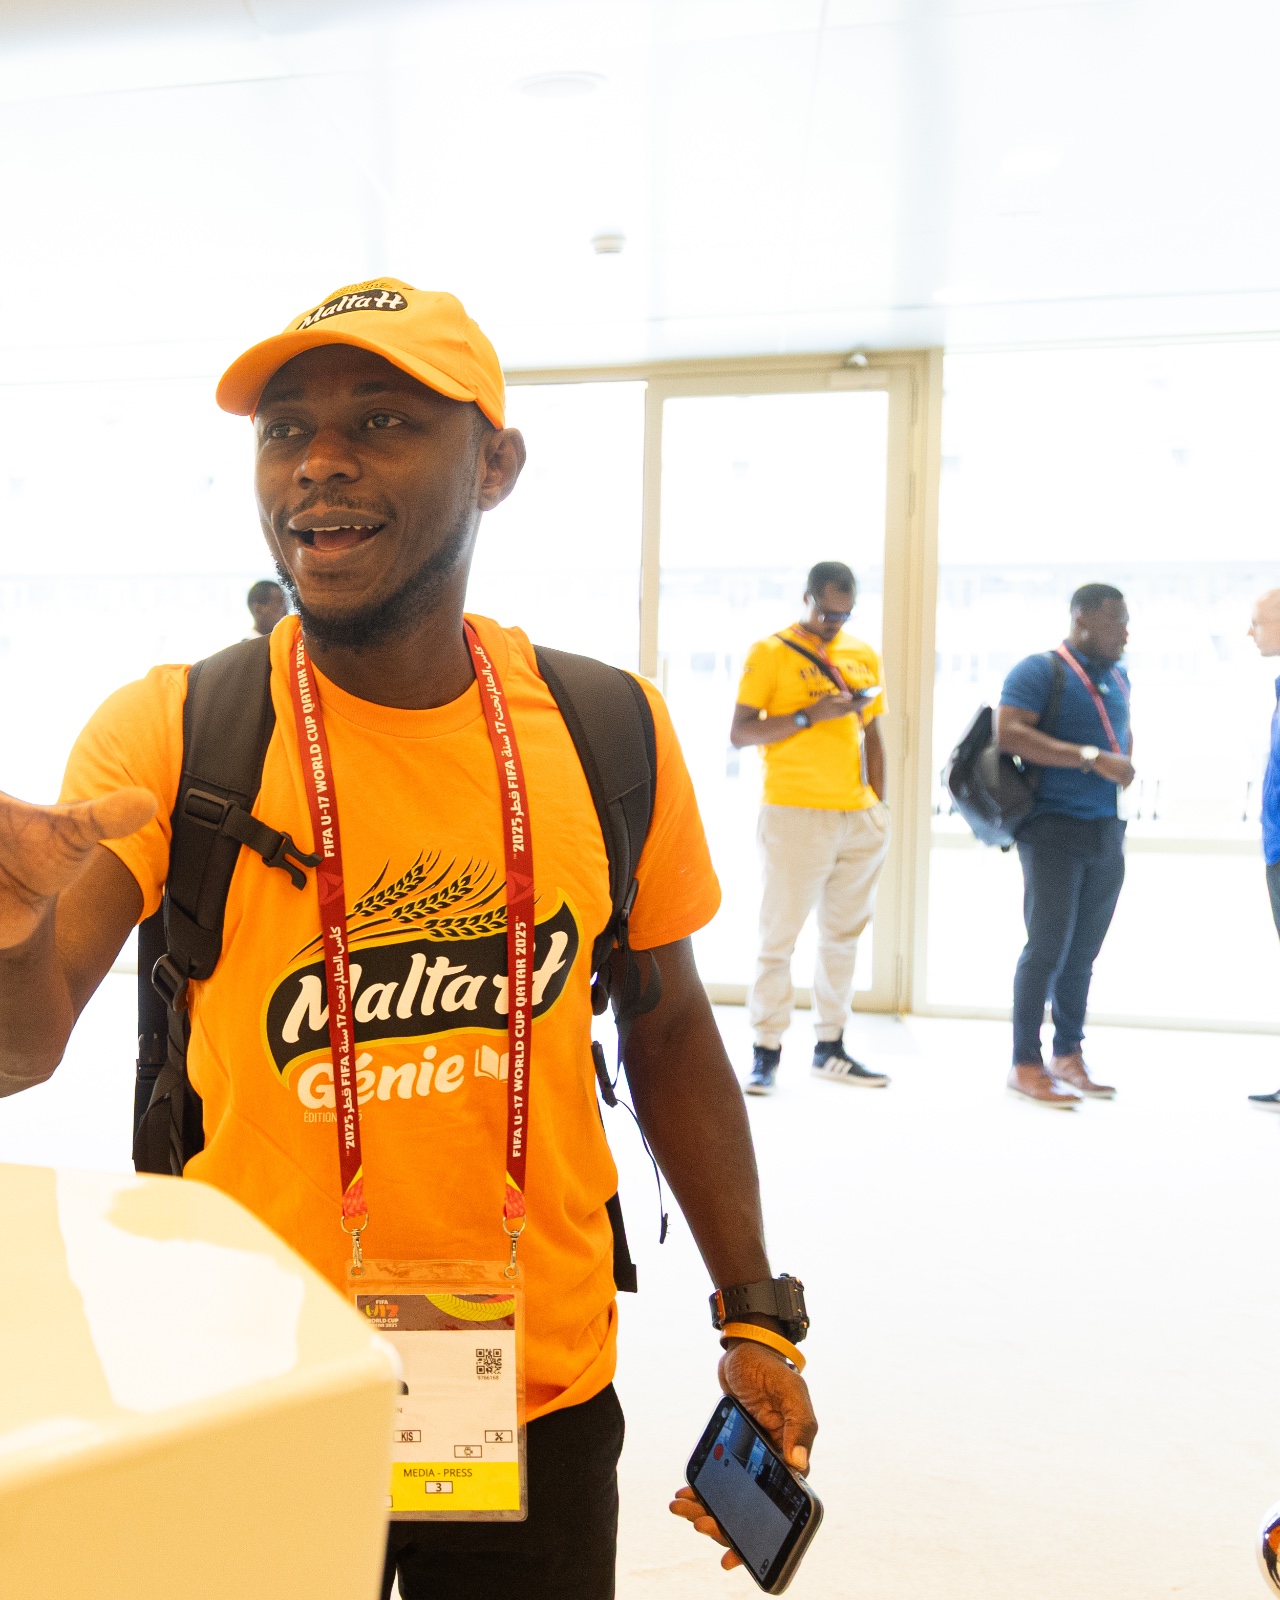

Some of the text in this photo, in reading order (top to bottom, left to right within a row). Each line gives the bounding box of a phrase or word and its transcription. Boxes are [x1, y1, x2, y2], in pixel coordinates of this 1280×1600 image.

[474, 644, 492, 669] كأس
[297, 668, 315, 713] QATAR
[481, 669, 502, 695] العالم
[490, 694, 504, 721] تحت
[304, 715, 318, 742] CUP
[495, 721, 507, 734] 17
[501, 735, 513, 757] سنة
[309, 743, 328, 793] WORLD
[504, 759, 519, 789] FIFA
[317, 796, 332, 826] U-17
[508, 790, 525, 817] قطر
[322, 827, 335, 858] FIFA
[328, 926, 345, 954] كأس
[332, 955, 349, 984] العالم
[515, 958, 527, 1007] QATAR
[336, 984, 346, 1013] تحت
[336, 1014, 347, 1028] 17
[515, 1009, 525, 1038] CUP
[339, 1029, 350, 1053] سنة
[297, 1045, 465, 1110] Génie
[340, 1055, 351, 1087] FIFA
[513, 1040, 525, 1092] WORLD
[341, 1087, 356, 1113] قطر
[513, 1095, 523, 1125] U-17
[303, 1110, 338, 1123] ÉDITION
[512, 1127, 523, 1158] FIFA
[403, 1468, 435, 1477] MEDIA
[443, 1468, 473, 1477] PRESS
[435, 1482, 442, 1492] 3
